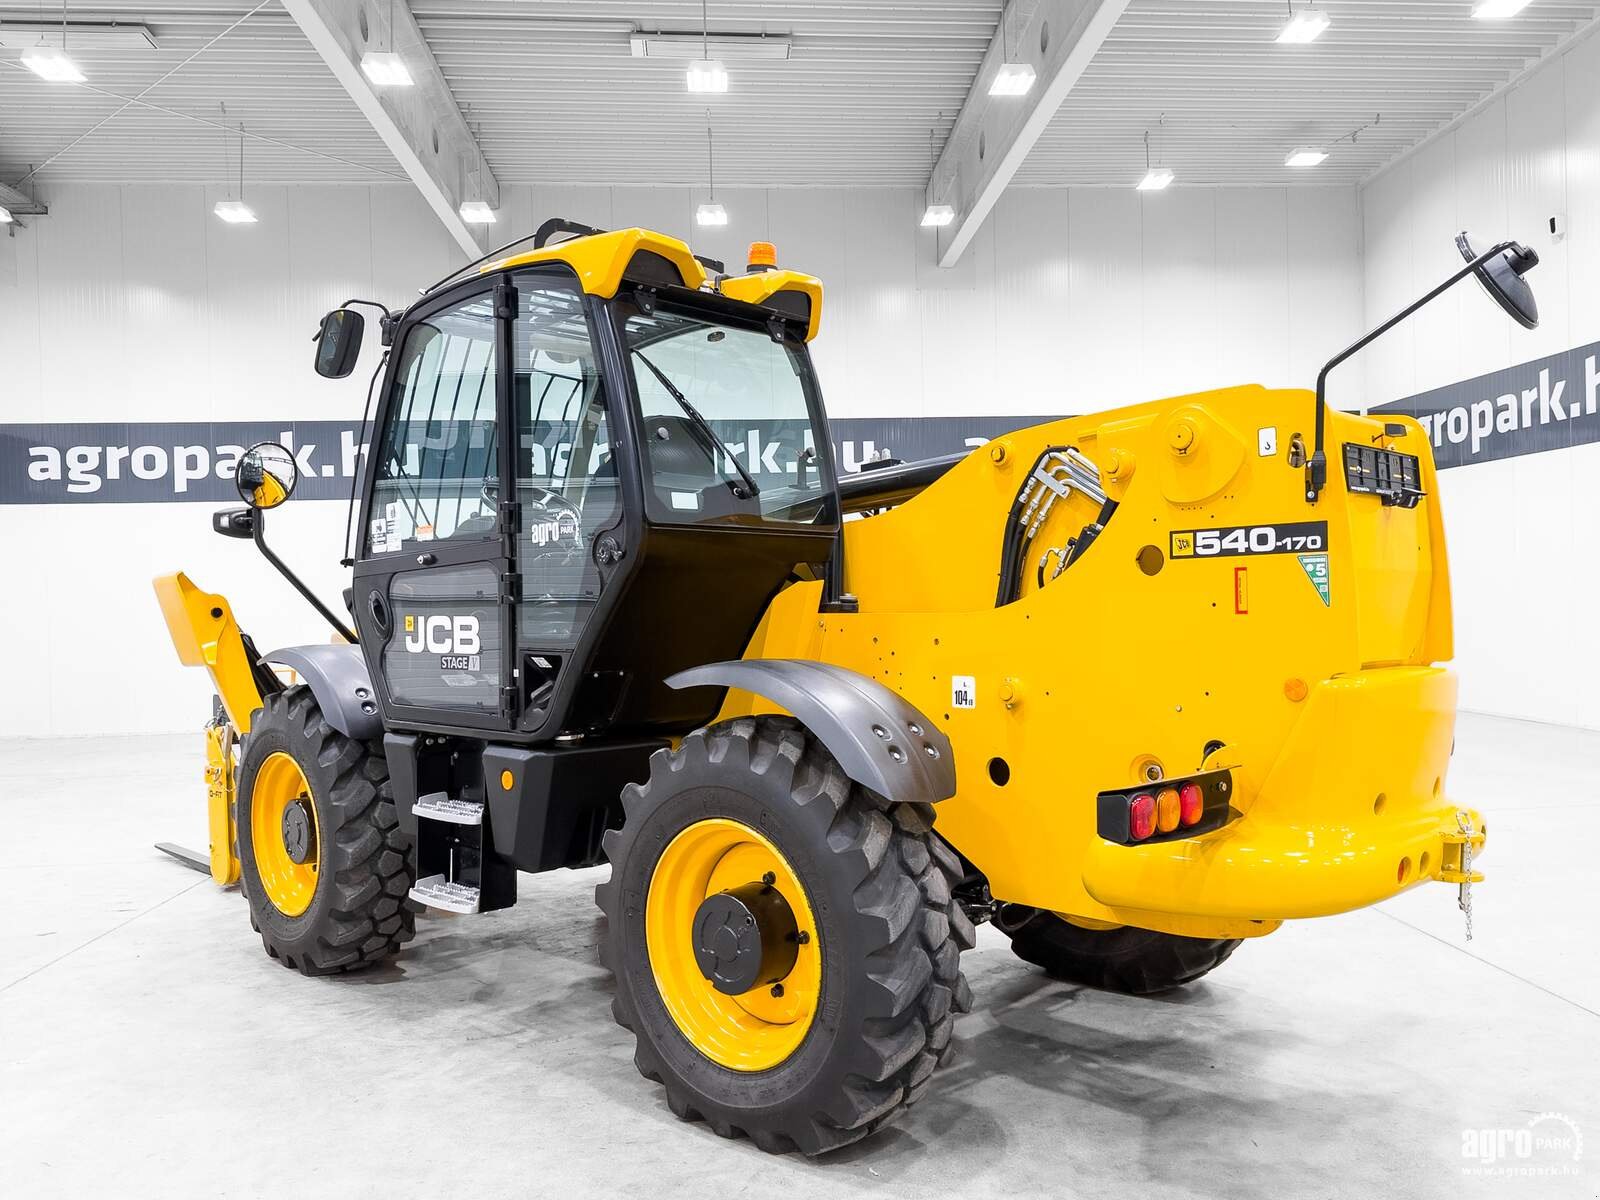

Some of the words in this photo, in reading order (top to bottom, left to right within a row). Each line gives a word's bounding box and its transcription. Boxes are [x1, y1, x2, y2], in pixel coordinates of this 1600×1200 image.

[531, 522, 560, 547] agro
[1195, 527, 1322, 555] 540-170
[1315, 563, 1326, 577] 5
[405, 615, 480, 654] JCB
[441, 656, 468, 669] STAGE
[954, 690, 968, 706] 104
